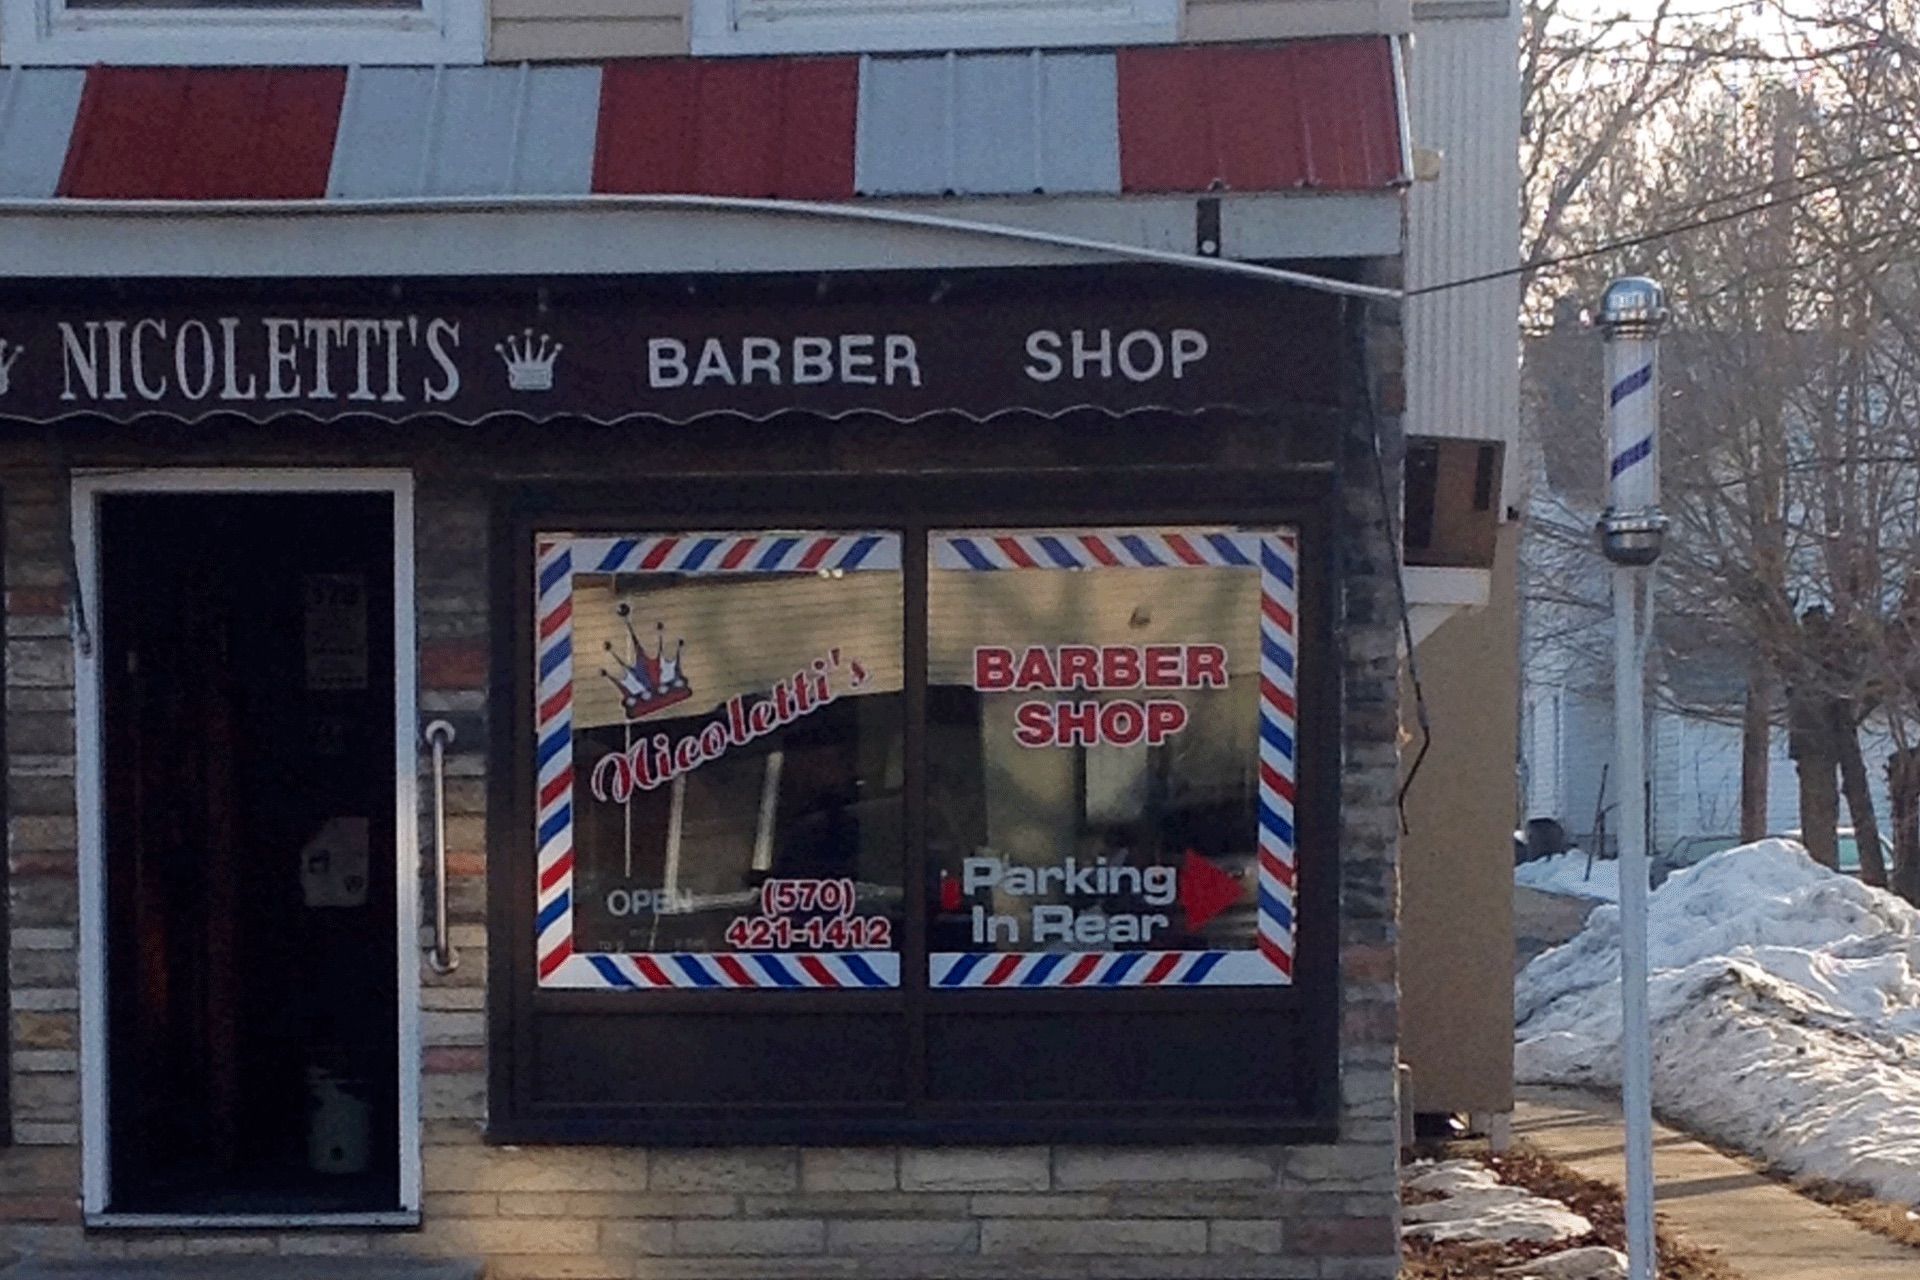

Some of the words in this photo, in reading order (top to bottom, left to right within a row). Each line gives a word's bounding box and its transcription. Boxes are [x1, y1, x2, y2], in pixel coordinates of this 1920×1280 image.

[58, 316, 461, 402] NICOLETTI'S
[647, 334, 922, 388] BARBER
[1024, 328, 1209, 381] SHOP
[974, 643, 1229, 691] BARBER
[591, 647, 868, 803] Nicoletti's
[1013, 700, 1188, 748] SHOP
[606, 887, 694, 917] OPEN
[761, 878, 856, 918] (570)
[962, 856, 1177, 905] Parking
[725, 915, 892, 949] 421-1412
[971, 904, 1020, 944] In
[1032, 904, 1169, 944] Rear
